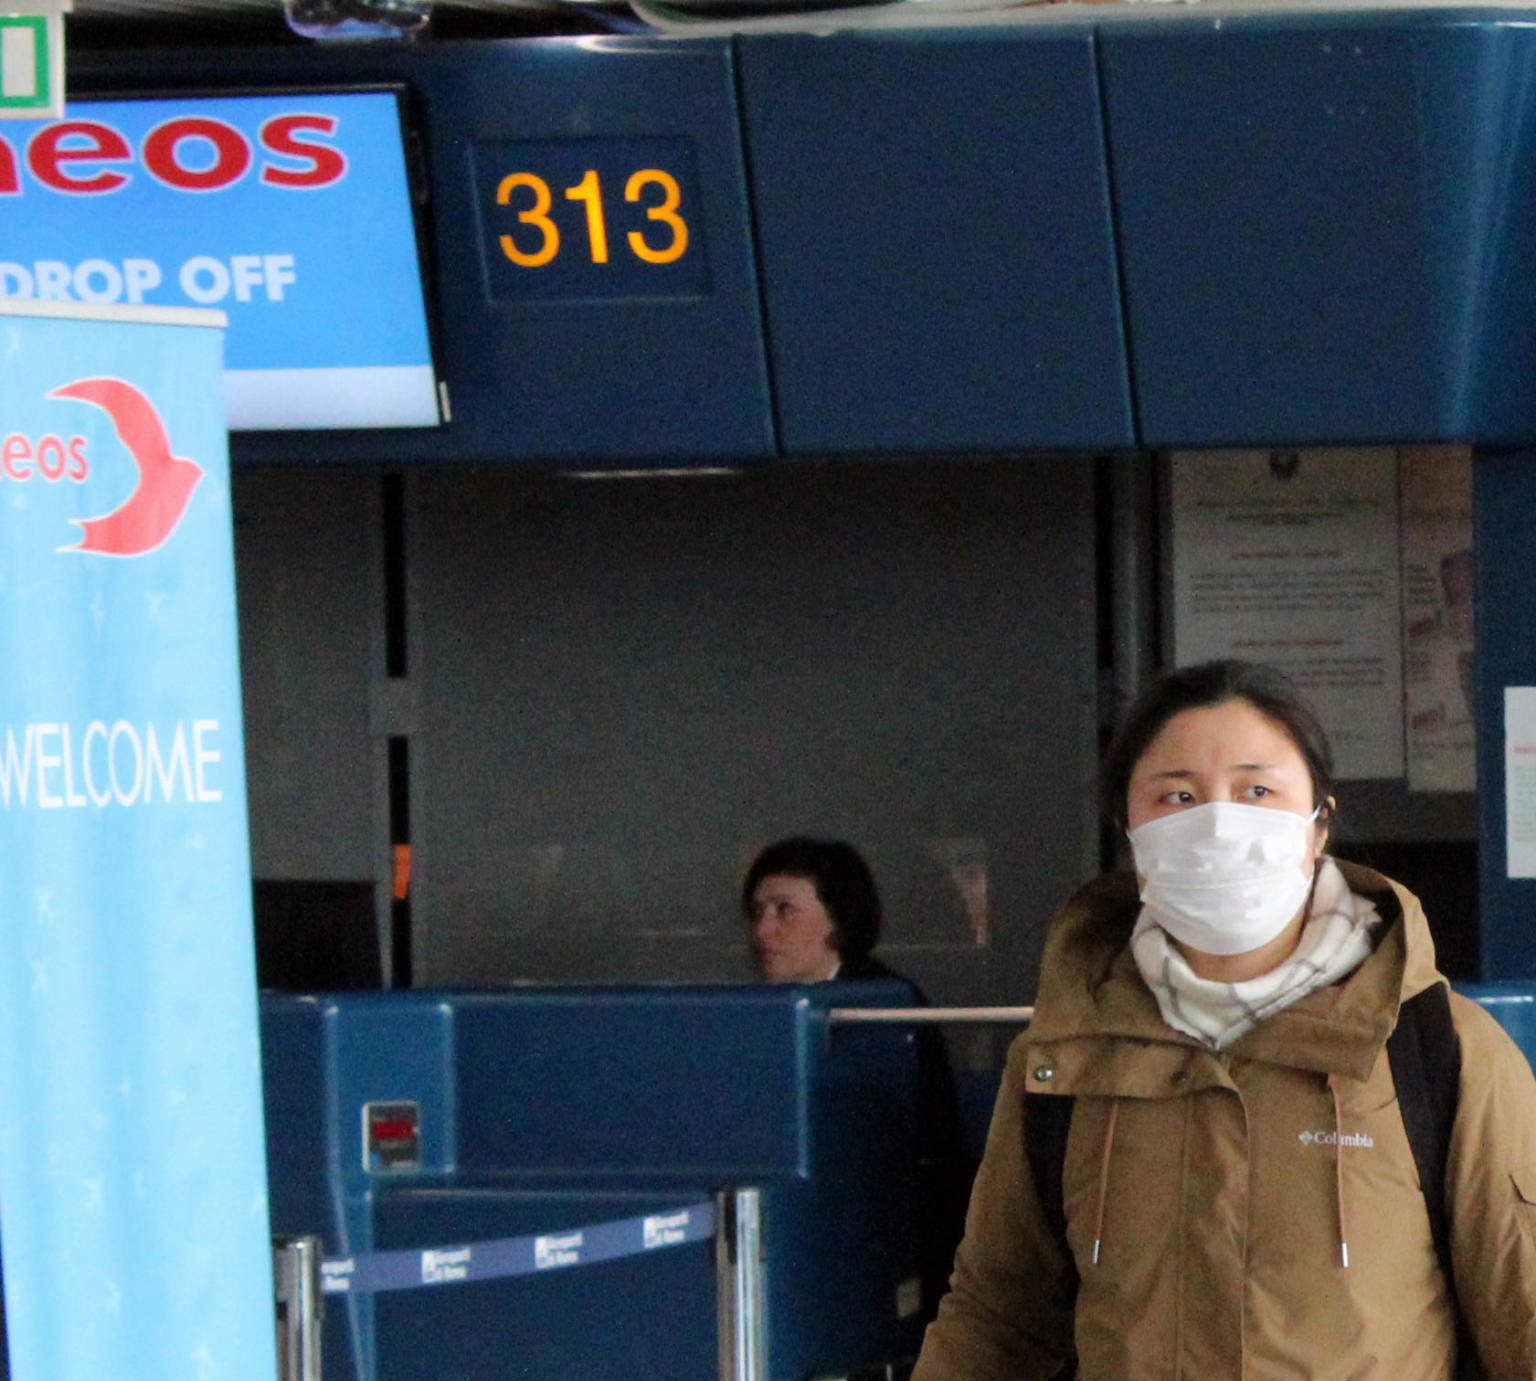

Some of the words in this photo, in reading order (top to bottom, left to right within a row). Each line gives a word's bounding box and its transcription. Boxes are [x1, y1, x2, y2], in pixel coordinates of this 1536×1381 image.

[496, 169, 690, 268] 313
[0, 257, 163, 304] DROP
[179, 254, 297, 304] OFF
[0, 718, 223, 809] WELCOME
